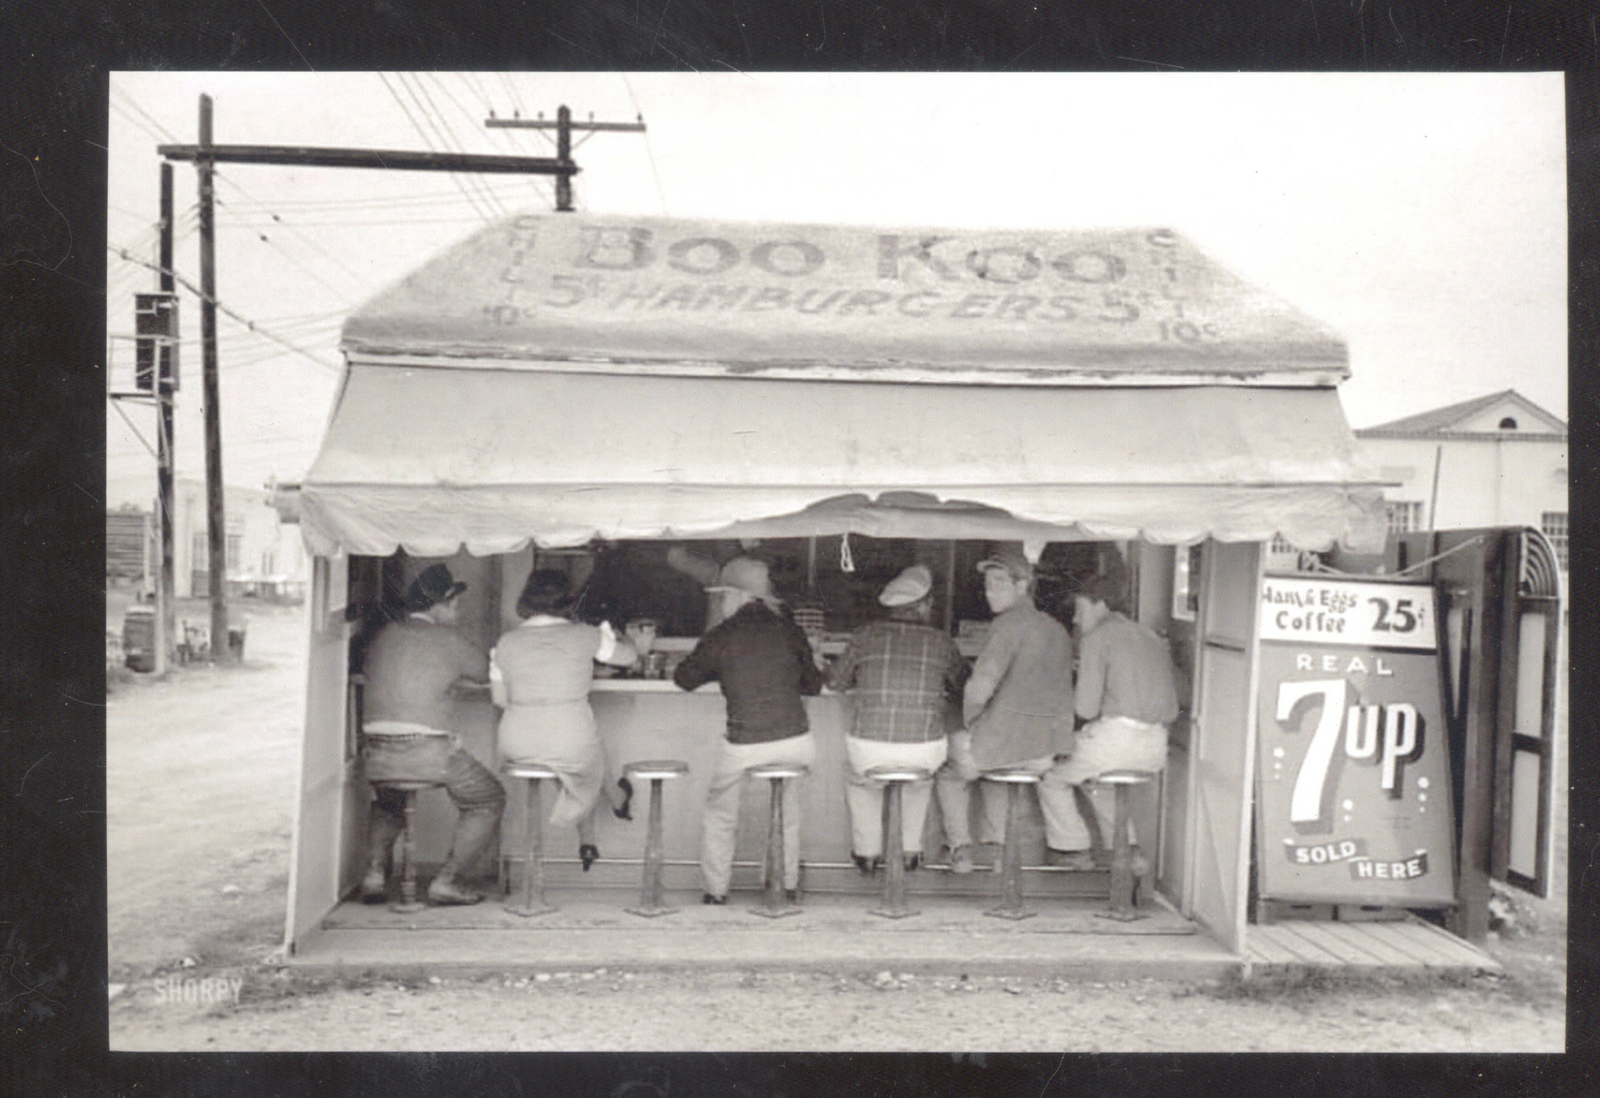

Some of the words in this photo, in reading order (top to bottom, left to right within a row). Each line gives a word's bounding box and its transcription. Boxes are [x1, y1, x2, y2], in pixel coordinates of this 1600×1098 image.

[574, 225, 826, 277] BOO
[877, 234, 1127, 284] KOO
[609, 281, 1080, 319] HAMBURGERS
[1320, 590, 1358, 613] Eggs
[1275, 610, 1346, 633] Coffee
[1296, 655, 1394, 676] REAL
[1295, 841, 1357, 865] SOLD
[1357, 859, 1422, 880] HERE
